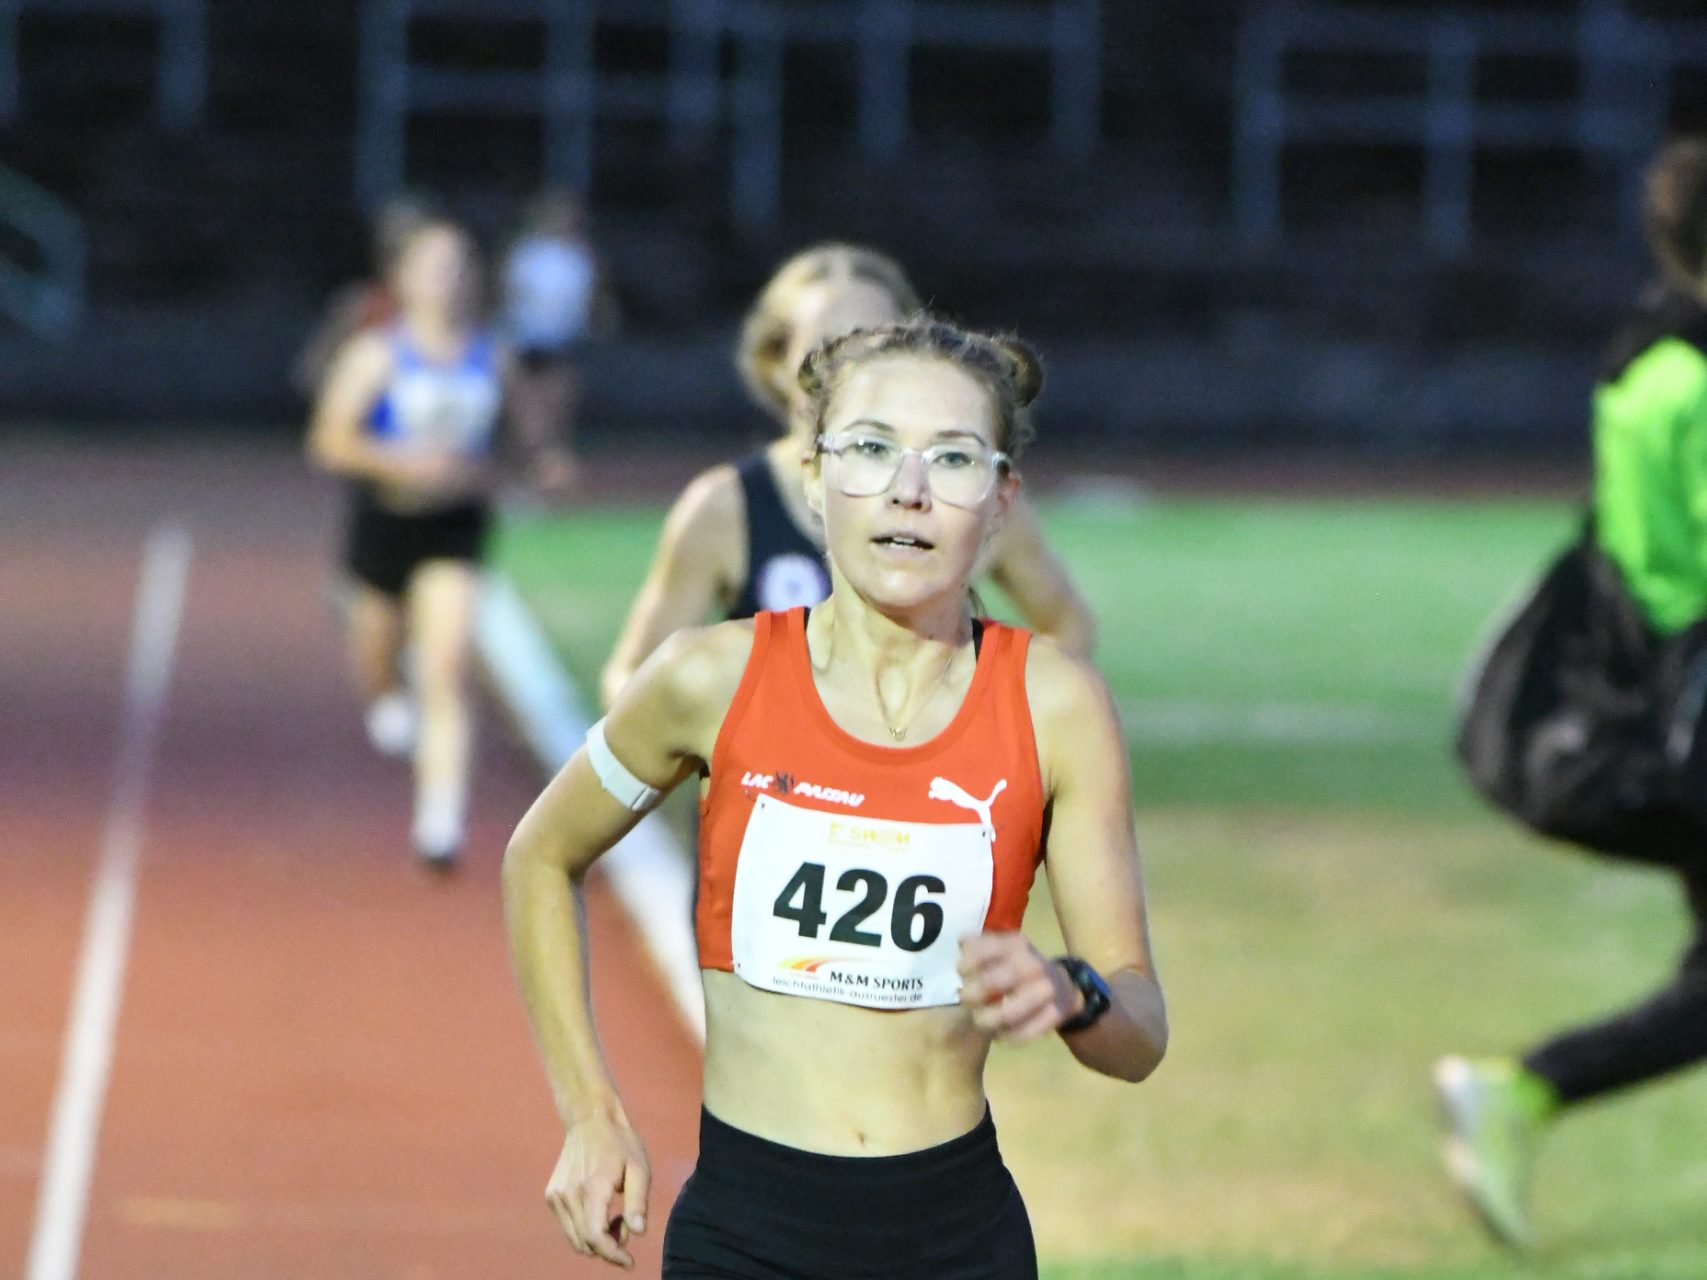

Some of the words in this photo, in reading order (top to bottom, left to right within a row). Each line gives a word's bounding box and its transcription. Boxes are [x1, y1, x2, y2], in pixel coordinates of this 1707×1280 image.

[741, 771, 774, 790] LAC
[793, 781, 865, 807] PASSAU
[773, 861, 946, 952] 426
[873, 976, 924, 990] SPORTS
